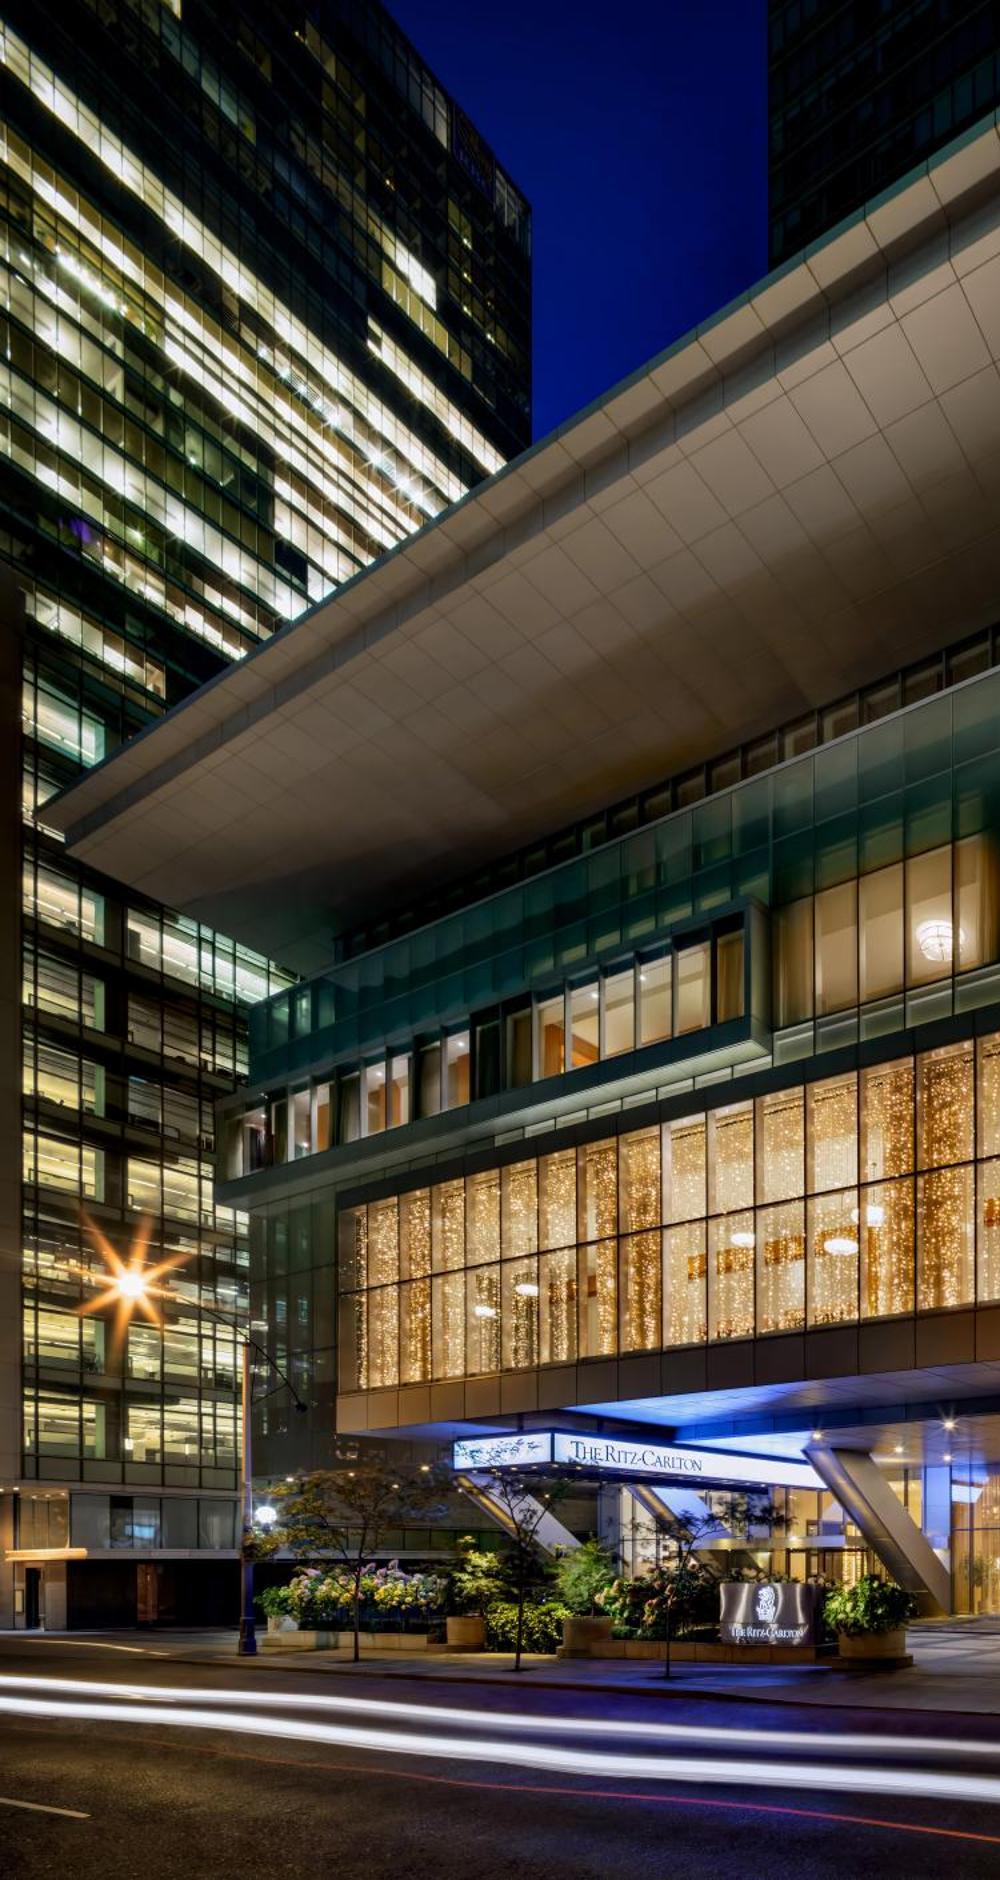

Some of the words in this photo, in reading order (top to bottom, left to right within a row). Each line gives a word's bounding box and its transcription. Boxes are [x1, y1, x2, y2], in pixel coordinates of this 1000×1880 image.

[570, 1440, 602, 1461] THE
[605, 1445, 702, 1472] RITZ-CARLTON
[731, 1624, 746, 1637] THE
[746, 1625, 804, 1639] RITZ-CARLTON
